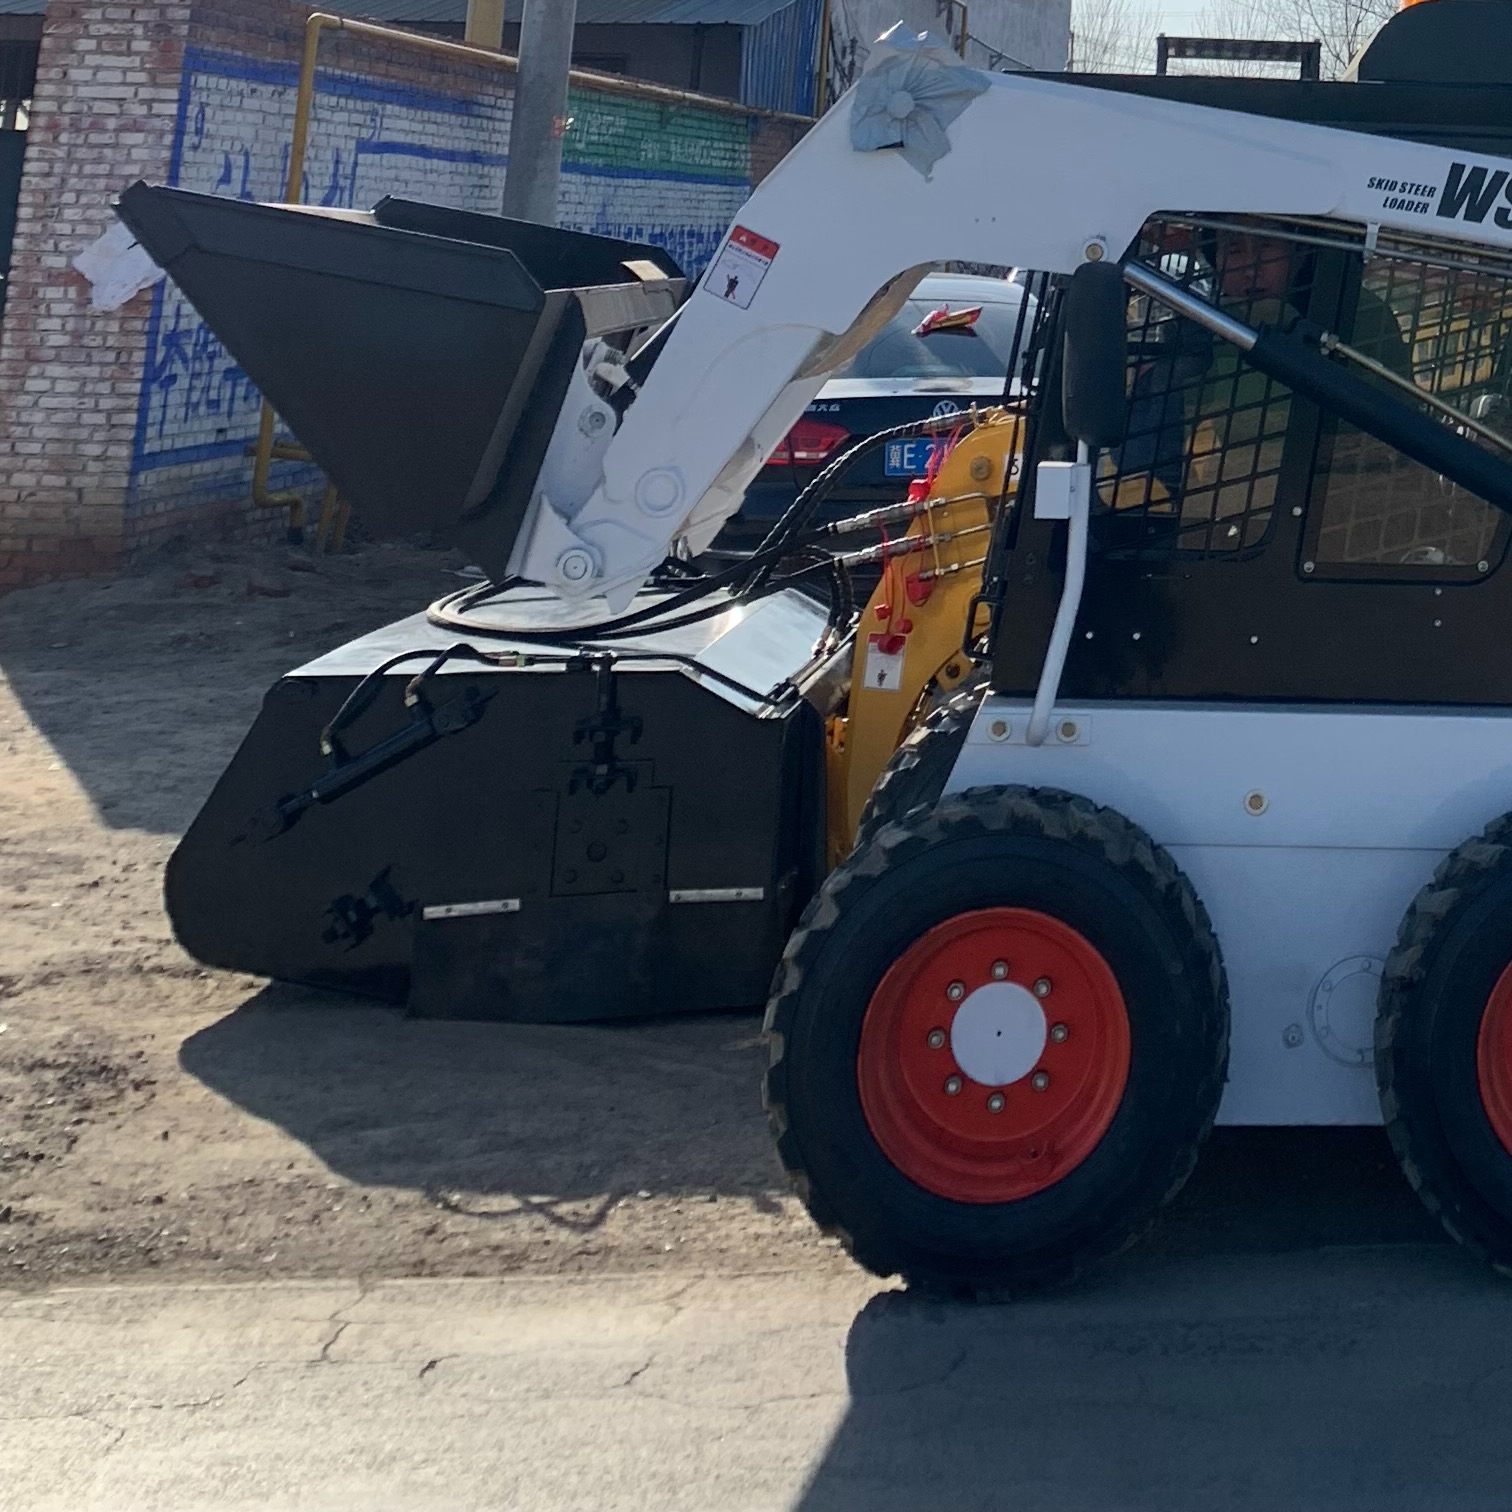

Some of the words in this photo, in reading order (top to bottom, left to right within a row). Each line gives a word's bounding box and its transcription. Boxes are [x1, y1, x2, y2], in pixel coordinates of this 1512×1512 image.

[1367, 176, 1399, 192] SKID
[1399, 181, 1437, 198] STEER
[1382, 196, 1430, 214] LOADER
